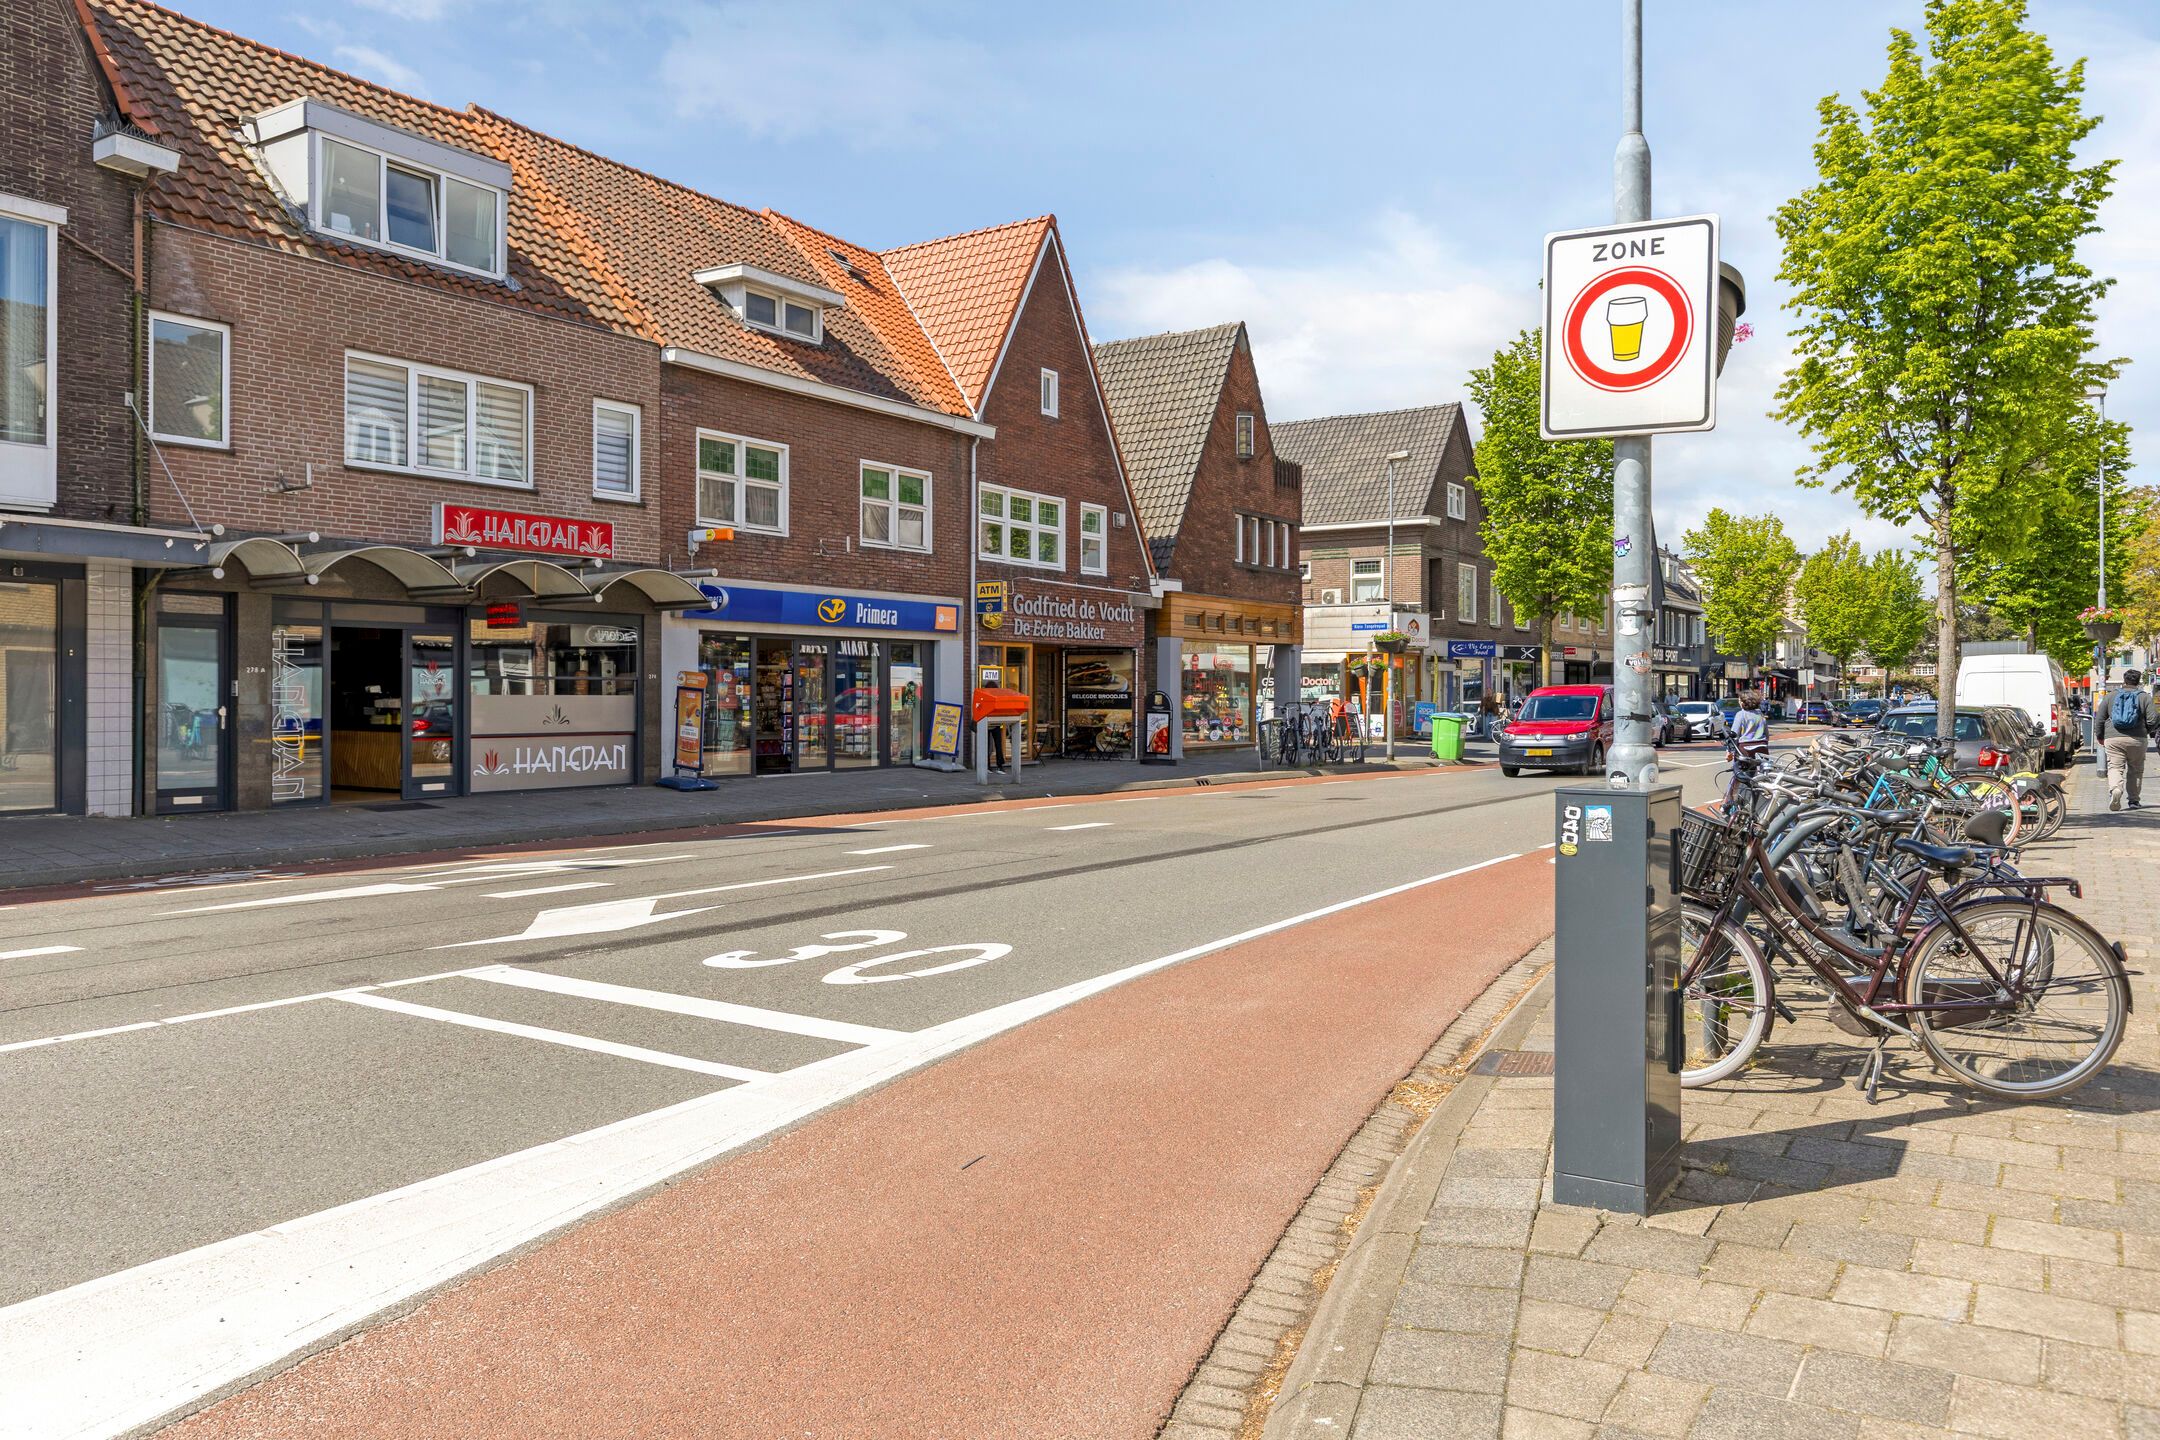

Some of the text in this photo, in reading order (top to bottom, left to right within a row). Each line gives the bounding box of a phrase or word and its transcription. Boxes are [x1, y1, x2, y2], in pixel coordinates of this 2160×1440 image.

[1593, 236, 1665, 262] ZONE
[483, 515, 579, 551] HANEDAN
[979, 586, 999, 595] ATM
[856, 602, 898, 626] Primera
[1012, 593, 1077, 618] Godfried
[1079, 599, 1096, 618] de
[1098, 602, 1135, 623] Vocht
[1013, 618, 1031, 637] De
[1032, 619, 1065, 638] Echte
[1066, 624, 1106, 641] Bakker
[984, 671, 998, 679] ATM
[1261, 676, 1333, 687] GS Doctor
[271, 629, 305, 801] HANEDAN
[513, 744, 627, 774] HANEDAN
[701, 928, 1014, 985] 30
[1787, 928, 1823, 964] CORTINA
